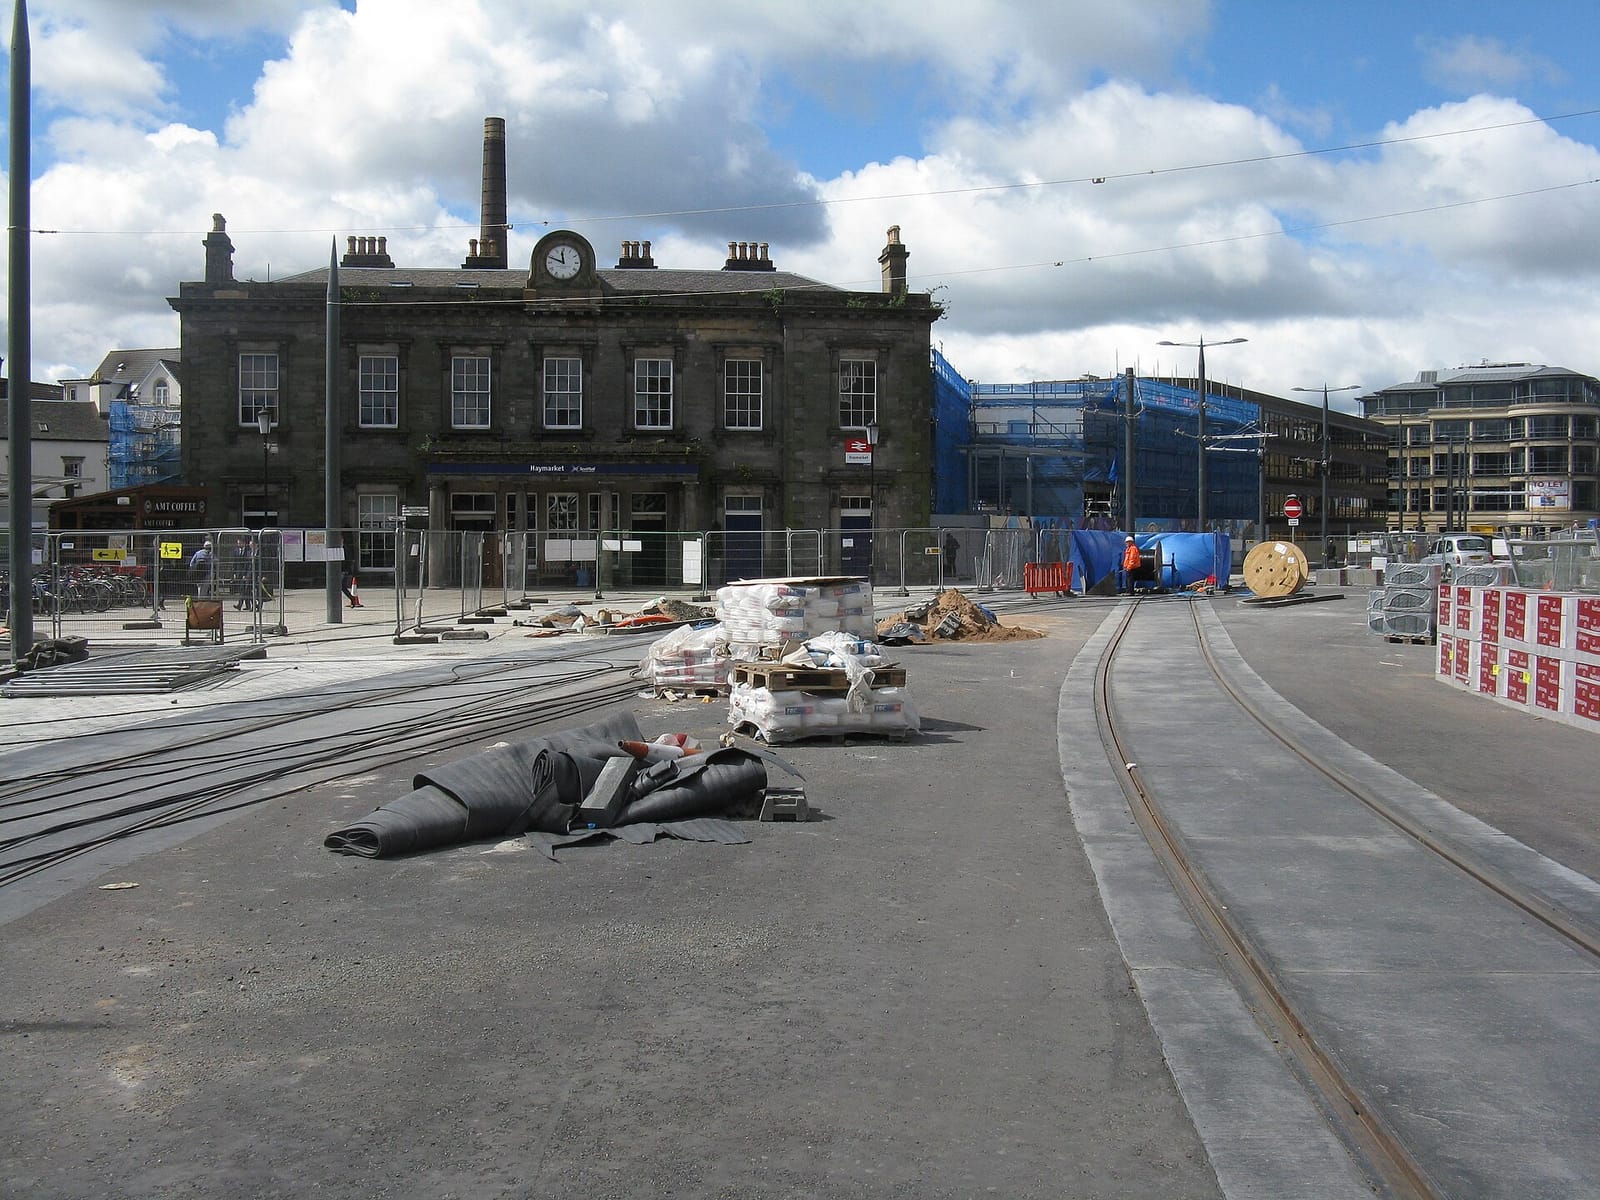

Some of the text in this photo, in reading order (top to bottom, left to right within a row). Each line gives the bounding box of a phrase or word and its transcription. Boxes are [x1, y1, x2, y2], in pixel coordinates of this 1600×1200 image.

[530, 465, 565, 473] Haymarket
[154, 502, 197, 511] AMT COFFEE
